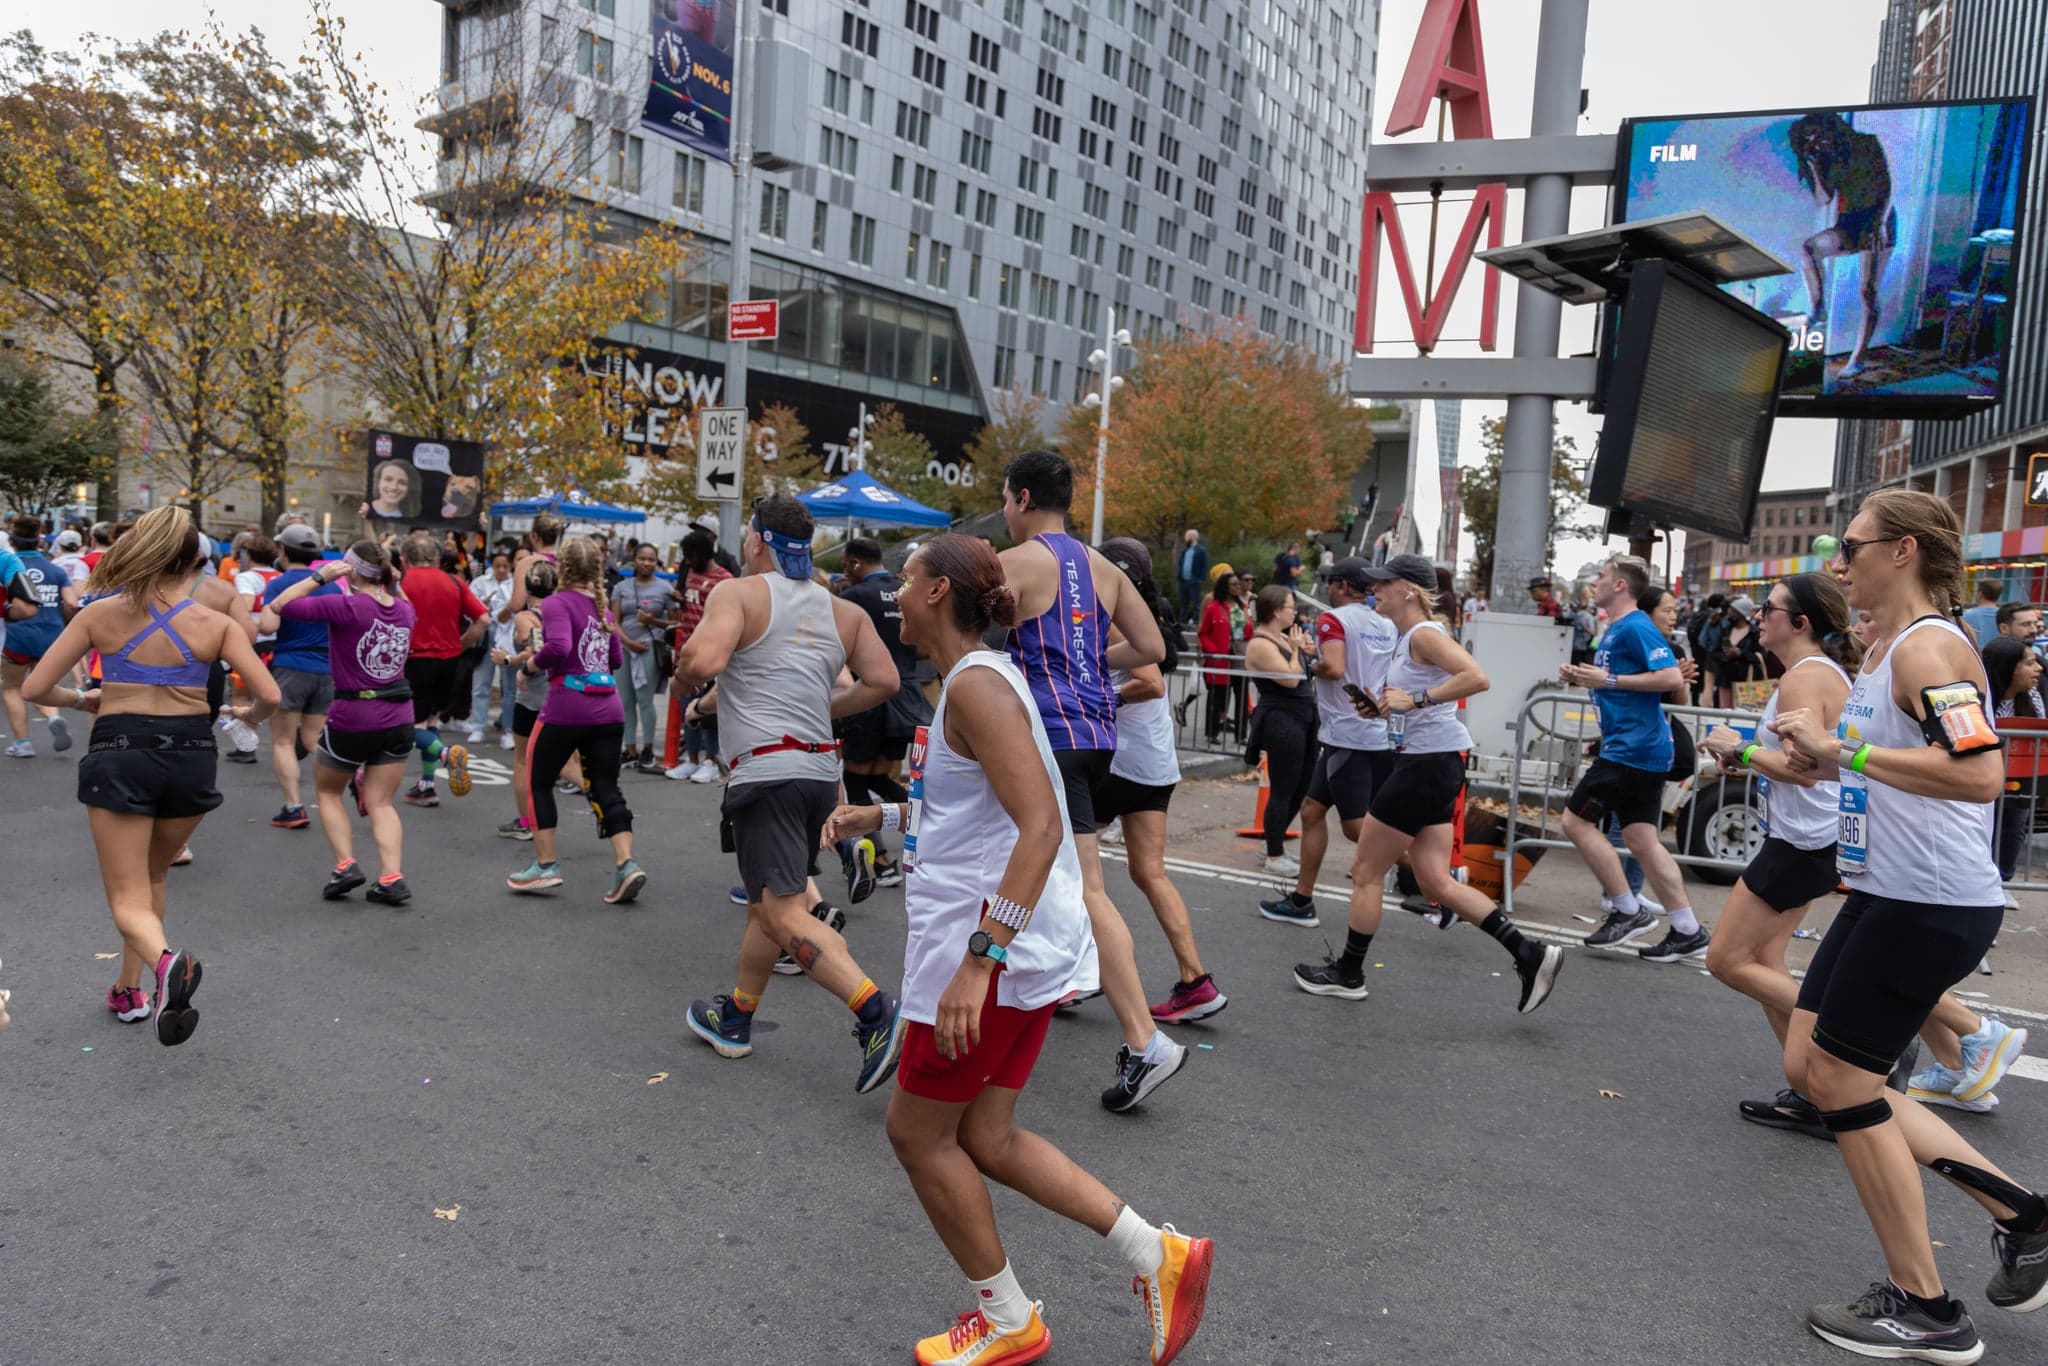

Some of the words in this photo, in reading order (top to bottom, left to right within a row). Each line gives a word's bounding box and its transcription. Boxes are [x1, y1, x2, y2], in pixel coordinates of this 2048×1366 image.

[693, 62, 722, 90] NOV.
[721, 79, 731, 95] 6
[1650, 144, 1697, 162] FILM
[624, 358, 723, 408] NOW
[708, 416, 737, 436] ONE
[706, 440, 737, 461] WAY
[1066, 559, 1082, 608] TEAM
[1073, 626, 1091, 684] REEVE
[1150, 1285, 1165, 1333] ATREYU
